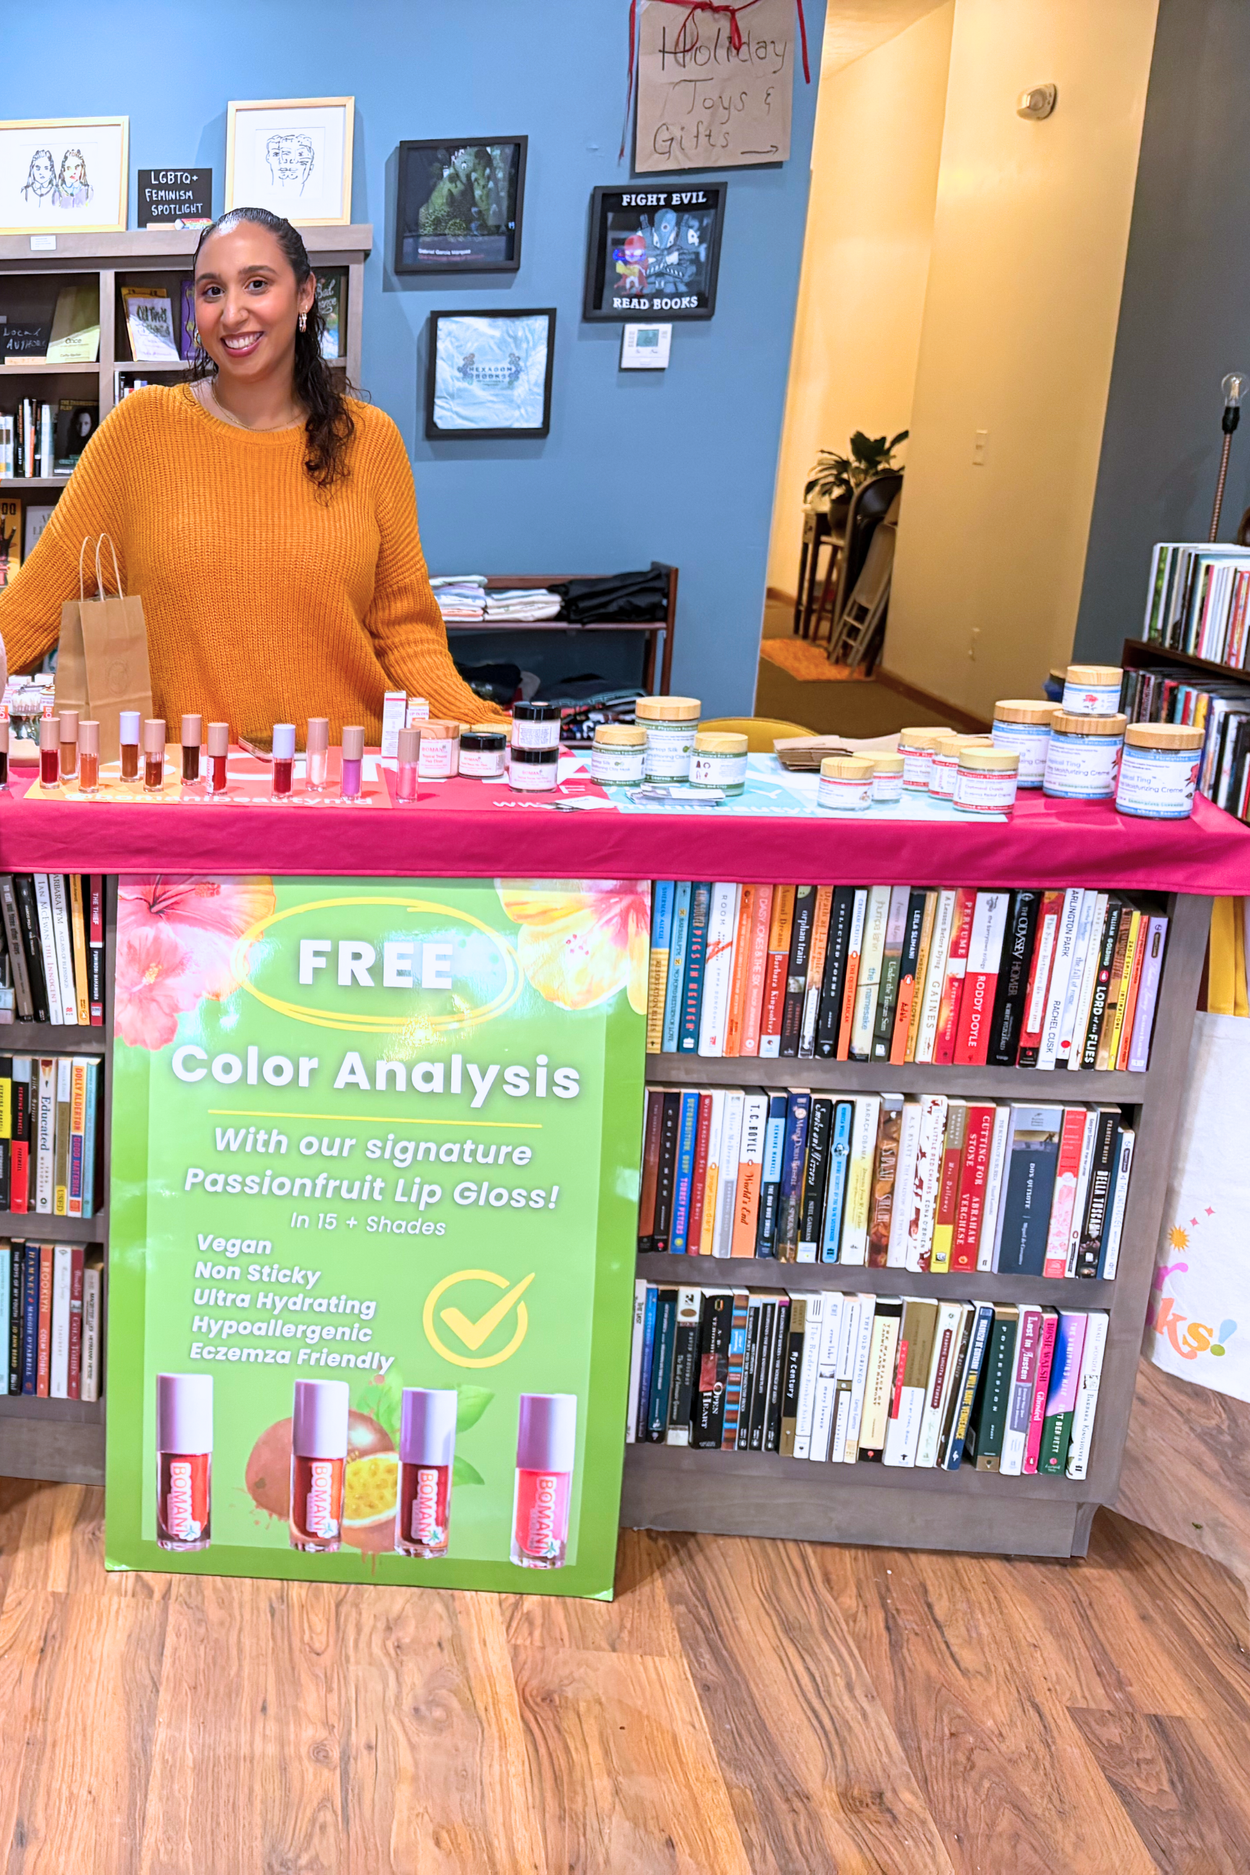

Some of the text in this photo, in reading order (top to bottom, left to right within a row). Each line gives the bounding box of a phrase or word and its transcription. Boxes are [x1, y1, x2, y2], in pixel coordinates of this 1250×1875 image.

[659, 26, 787, 74] Holiday
[672, 77, 748, 125] Toys
[653, 120, 730, 161] Gifts
[146, 188, 193, 201] FEMINISM
[151, 171, 198, 185] LGBTQ+
[622, 191, 707, 206] FIGHT EVIL
[151, 203, 203, 216] SPOTLIGHT
[613, 296, 698, 310] READ BOOKS
[38, 881, 46, 897] IAN
[719, 895, 728, 925] ROOM
[753, 899, 768, 973] DAISY JONES THE
[796, 910, 809, 964] orphan train
[912, 910, 921, 929] LEILA
[958, 902, 972, 955] PERFUME
[298, 938, 454, 991] FREE
[690, 930, 702, 977] PIGS IN
[1008, 917, 1029, 996] ODYSSEY HOMER
[1045, 890, 1079, 1054] ARLINGTON PARK RACHEL CUSK
[767, 955, 783, 1033] Barbara Kingsolver
[861, 968, 876, 1030] the namesake
[926, 981, 940, 1029] GAINES
[1084, 911, 1119, 1063] WILLIAM LORD FLIES
[968, 976, 986, 1047] RODDY DOYLE
[170, 1044, 581, 1109] Color Analysis
[40, 1097, 50, 1151] Educated
[74, 1093, 82, 1131] ALDERTON
[813, 1104, 827, 1131] Smoke
[860, 1103, 872, 1161] BARACK OBAMA
[214, 1126, 532, 1169] With our signature
[965, 1134, 977, 1167] STONE
[974, 1116, 990, 1185] CUTTING FOR
[72, 1160, 80, 1195] MATERIAL
[184, 1167, 561, 1211] Passionfruit Lip Gloss!
[740, 1127, 759, 1226] BOYLE End
[1028, 1163, 1036, 1178] DON
[1094, 1170, 1109, 1195] BELLA
[942, 1180, 953, 1213] Dalloway
[290, 1211, 447, 1237] In 15 + Shades
[676, 1207, 686, 1234] PETERS
[956, 1194, 969, 1245] VERGHESE
[967, 1196, 980, 1244] ABRAHAM
[197, 1233, 272, 1258] Vegan
[27, 1251, 35, 1295] HAMNET
[40, 1261, 50, 1312] BROOKLYN
[195, 1261, 321, 1289] Non Sticky
[193, 1288, 377, 1320] Ultra Hydrating
[192, 1315, 373, 1344] Hypoallergenic
[1020, 1316, 1038, 1380] Lost in Austen
[1152, 1298, 1237, 1359] ks!
[189, 1342, 395, 1375] Eczemza Friendly
[1033, 1322, 1055, 1421] ROSIE WALSH Ghosted
[711, 1382, 723, 1415] OPEN
[787, 1364, 798, 1399] Century
[701, 1391, 712, 1429] HEART
[172, 1463, 188, 1538] BOMANI
[313, 1463, 331, 1533] BOMANI
[419, 1471, 438, 1540] BOMANI
[538, 1477, 555, 1552] BOMANI
